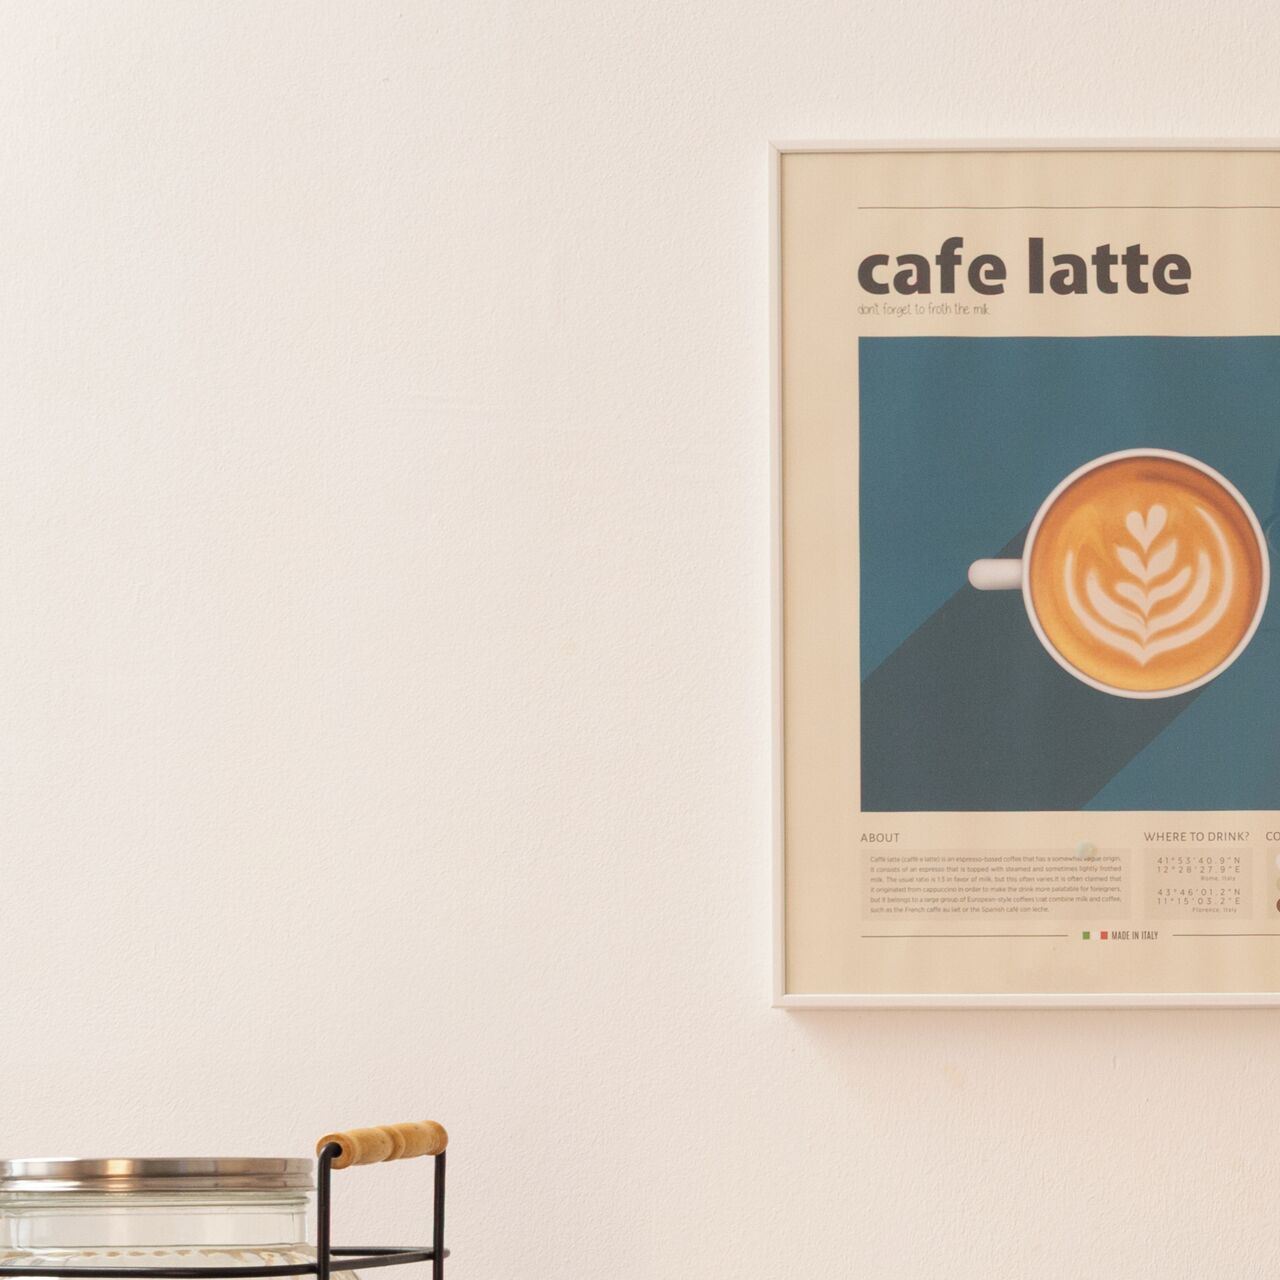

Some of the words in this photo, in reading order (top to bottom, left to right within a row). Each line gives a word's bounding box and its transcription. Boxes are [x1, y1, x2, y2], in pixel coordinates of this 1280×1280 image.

[857, 236, 1007, 296] cafe
[1028, 236, 1192, 296] latte
[860, 832, 900, 843] ABOUT
[1143, 831, 1187, 841] WHERE
[1190, 832, 1205, 841] TO
[1208, 831, 1250, 841] DRINK?
[1111, 931, 1130, 940] MADE
[1132, 931, 1140, 940] IN
[1141, 931, 1158, 940] ITALY
